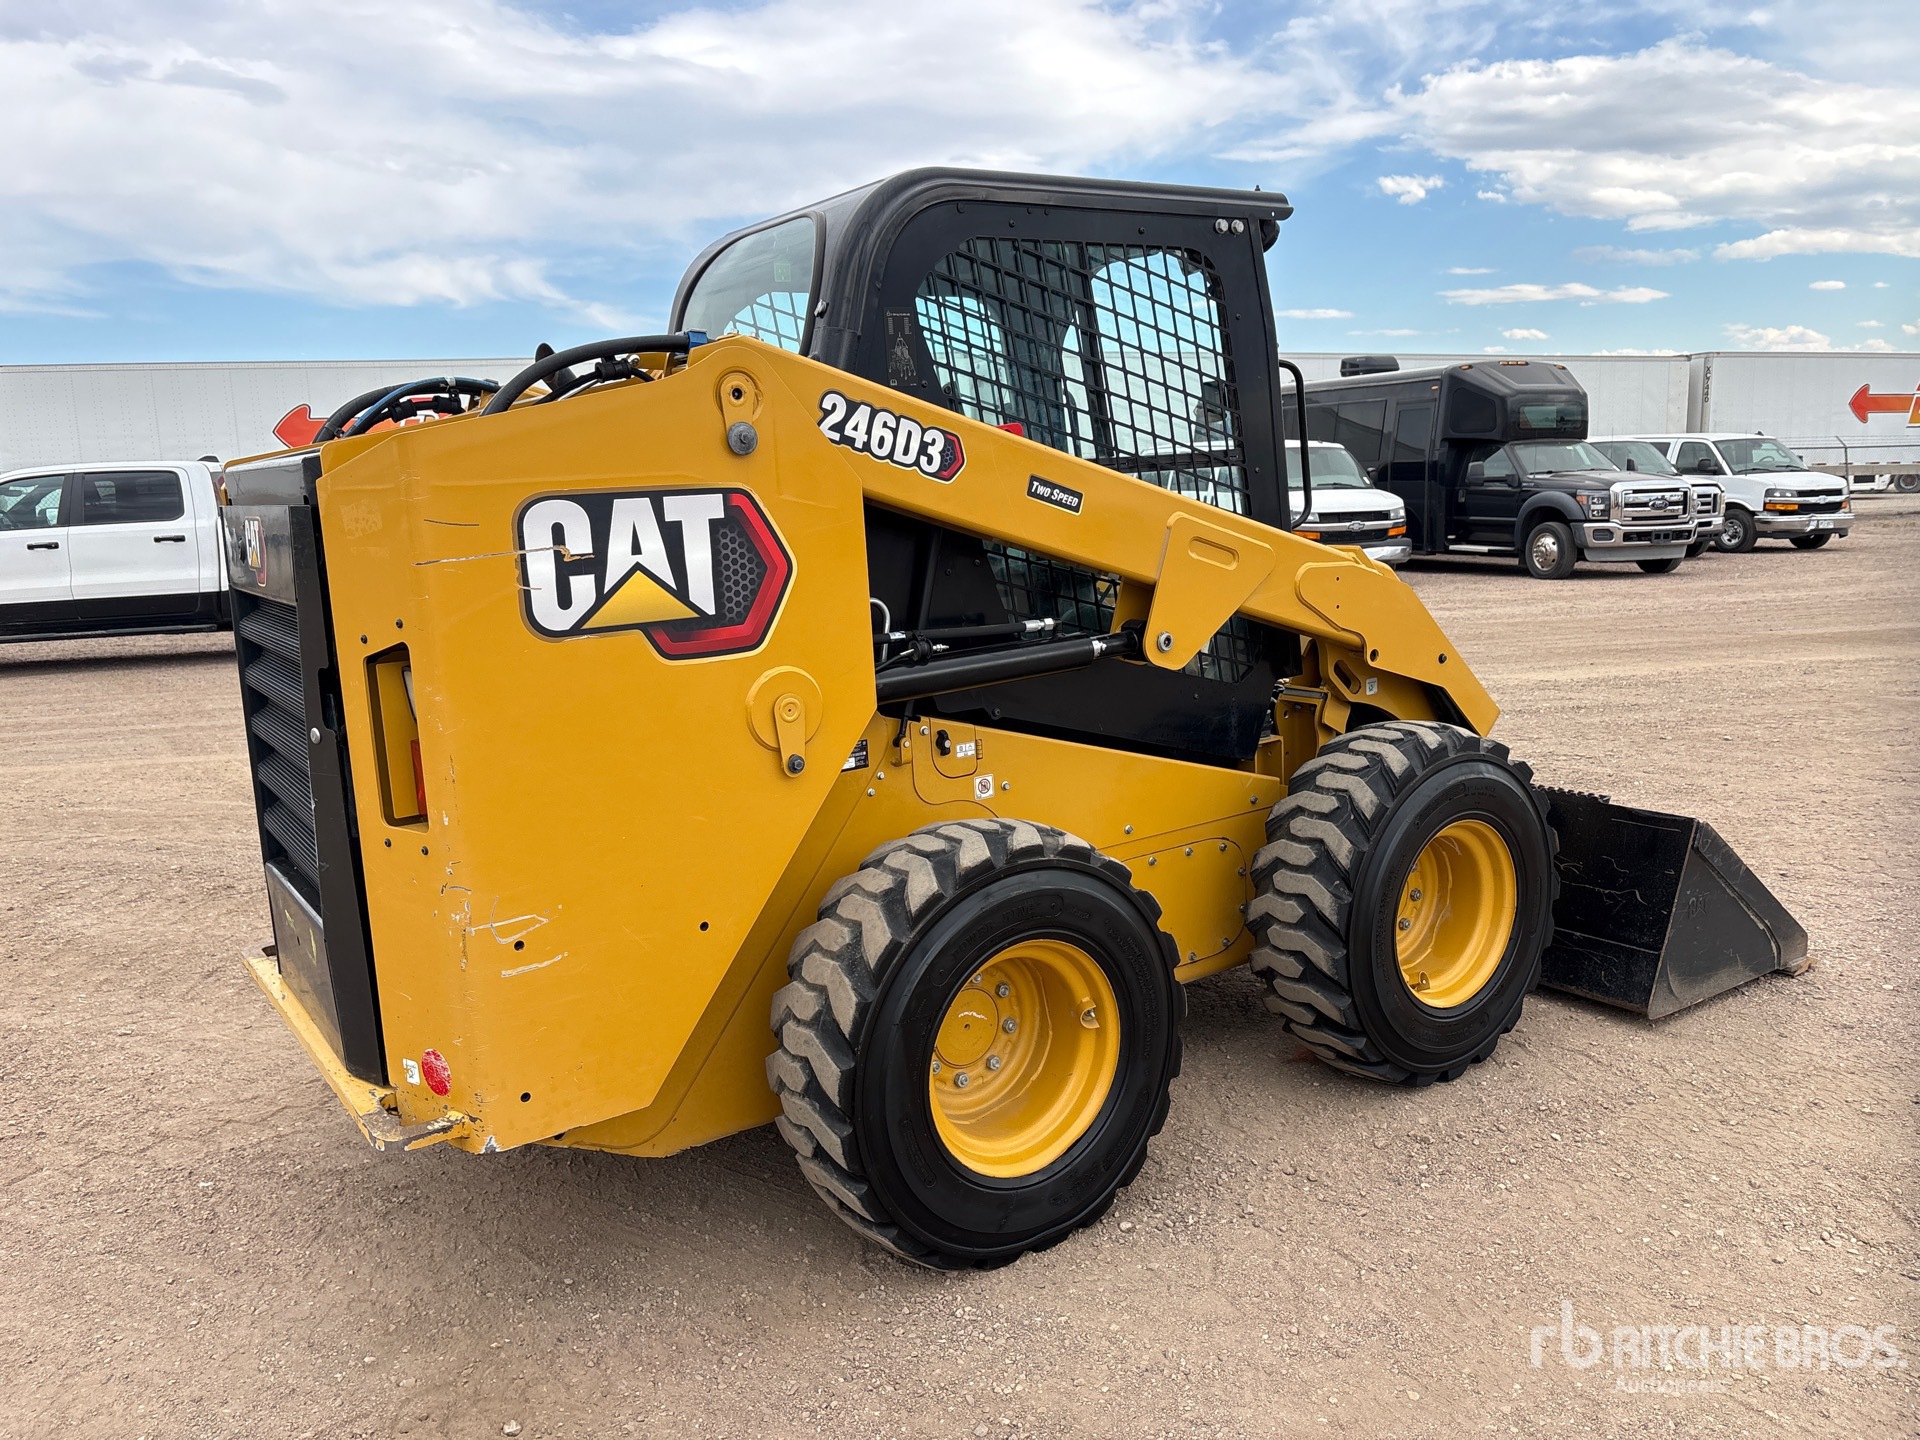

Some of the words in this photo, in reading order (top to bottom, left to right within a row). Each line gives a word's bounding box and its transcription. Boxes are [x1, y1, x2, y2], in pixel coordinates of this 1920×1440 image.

[1704, 365, 1712, 403] XC7440
[819, 393, 945, 474] 246D3
[244, 519, 261, 569] CAT
[522, 493, 725, 631] CAT
